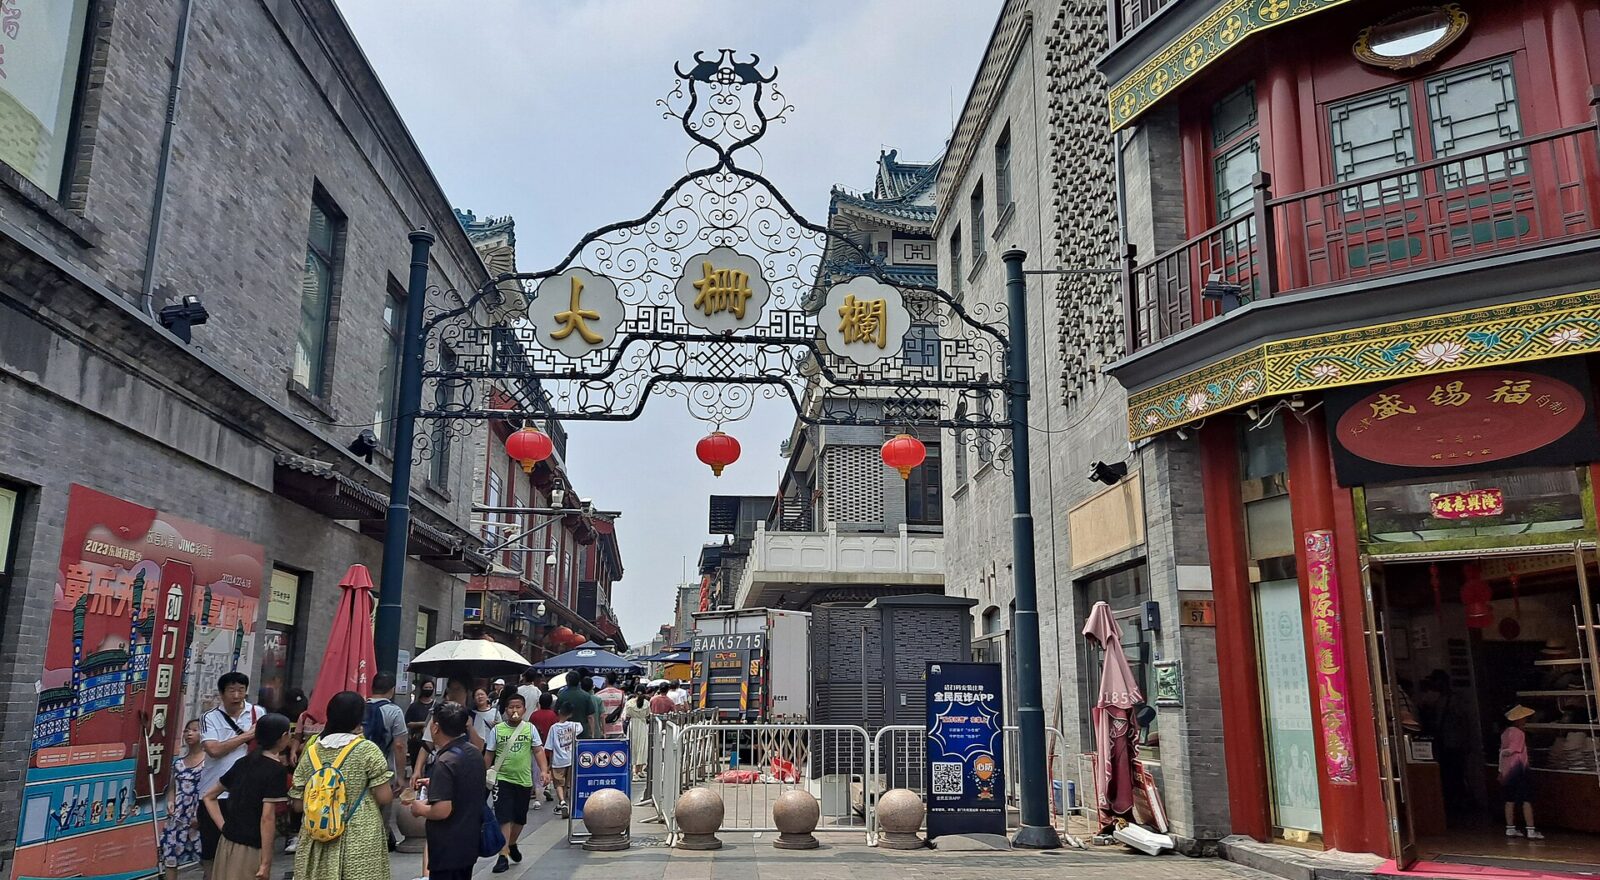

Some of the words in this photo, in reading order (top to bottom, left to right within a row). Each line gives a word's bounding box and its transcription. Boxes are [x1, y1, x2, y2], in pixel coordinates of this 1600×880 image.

[1369, 380, 1531, 420] 盛锡福
[1191, 610, 1204, 622] 57
[694, 635, 760, 651] 京AAK5715
[934, 691, 994, 702] 全民反诈APP
[499, 734, 530, 743] SHCK
[587, 778, 617, 786] 前门商业区
